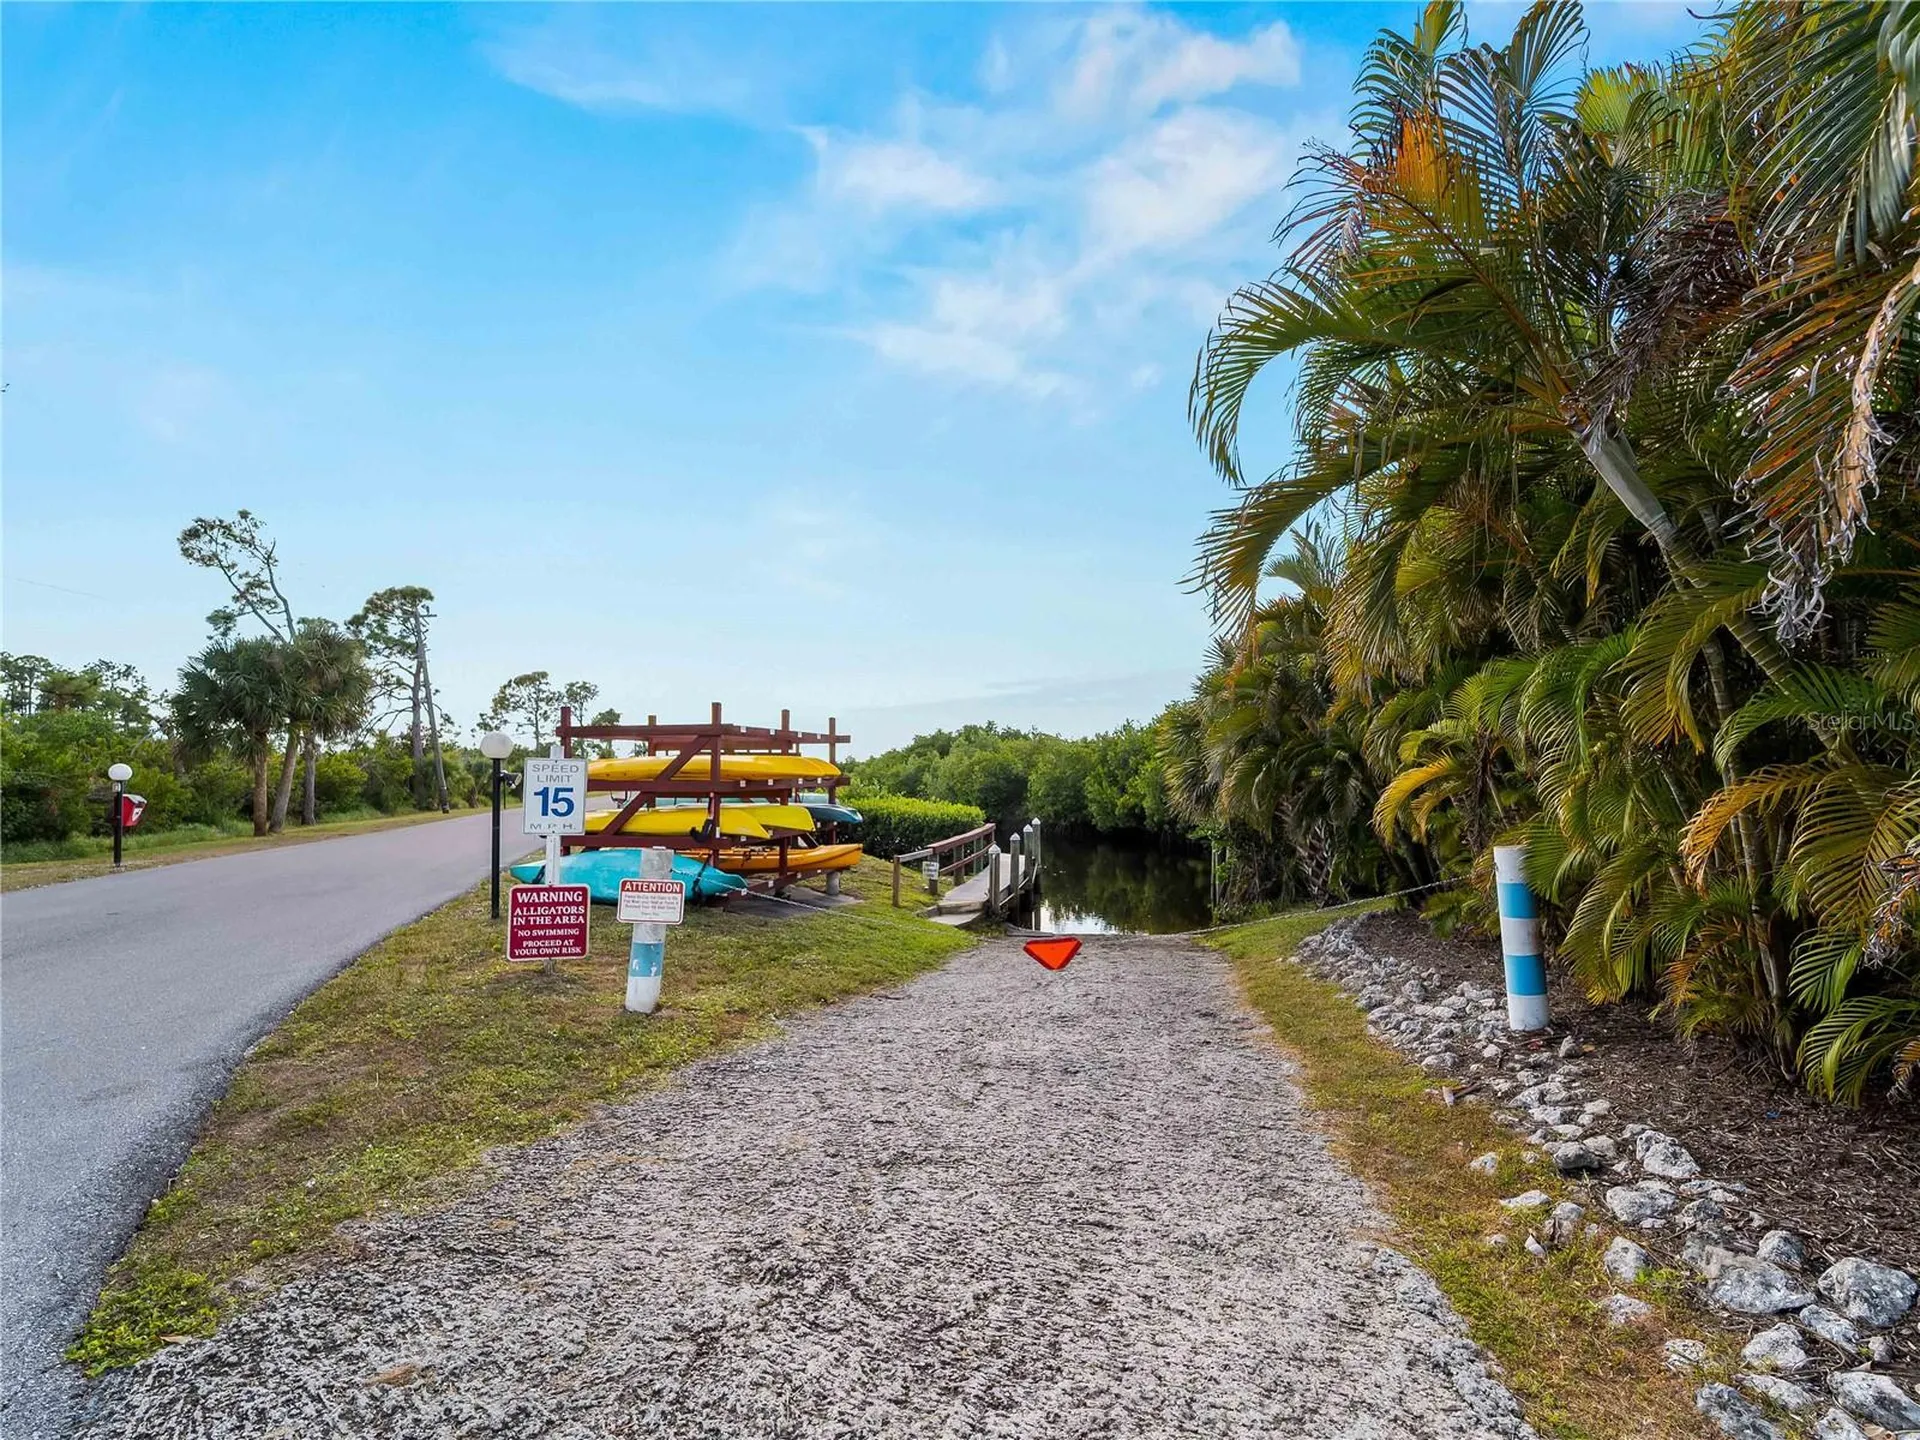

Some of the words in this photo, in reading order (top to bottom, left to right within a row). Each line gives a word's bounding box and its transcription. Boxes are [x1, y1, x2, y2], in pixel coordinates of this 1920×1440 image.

[532, 763, 579, 773] SPEED
[537, 774, 573, 783] LIMIT
[533, 786, 575, 817] 15
[624, 881, 680, 892] ATTENTION
[516, 891, 583, 903] WARNING
[513, 905, 585, 916] ALLIGATORS
[513, 916, 526, 926] IN
[528, 916, 552, 925] THE
[553, 915, 585, 924] AREA
[518, 929, 531, 937] NO
[532, 928, 580, 936] SWIMMING
[522, 939, 562, 947] PROCEED
[514, 948, 538, 956] YOUR
[539, 947, 560, 955] OWN
[561, 946, 582, 954] RISK
